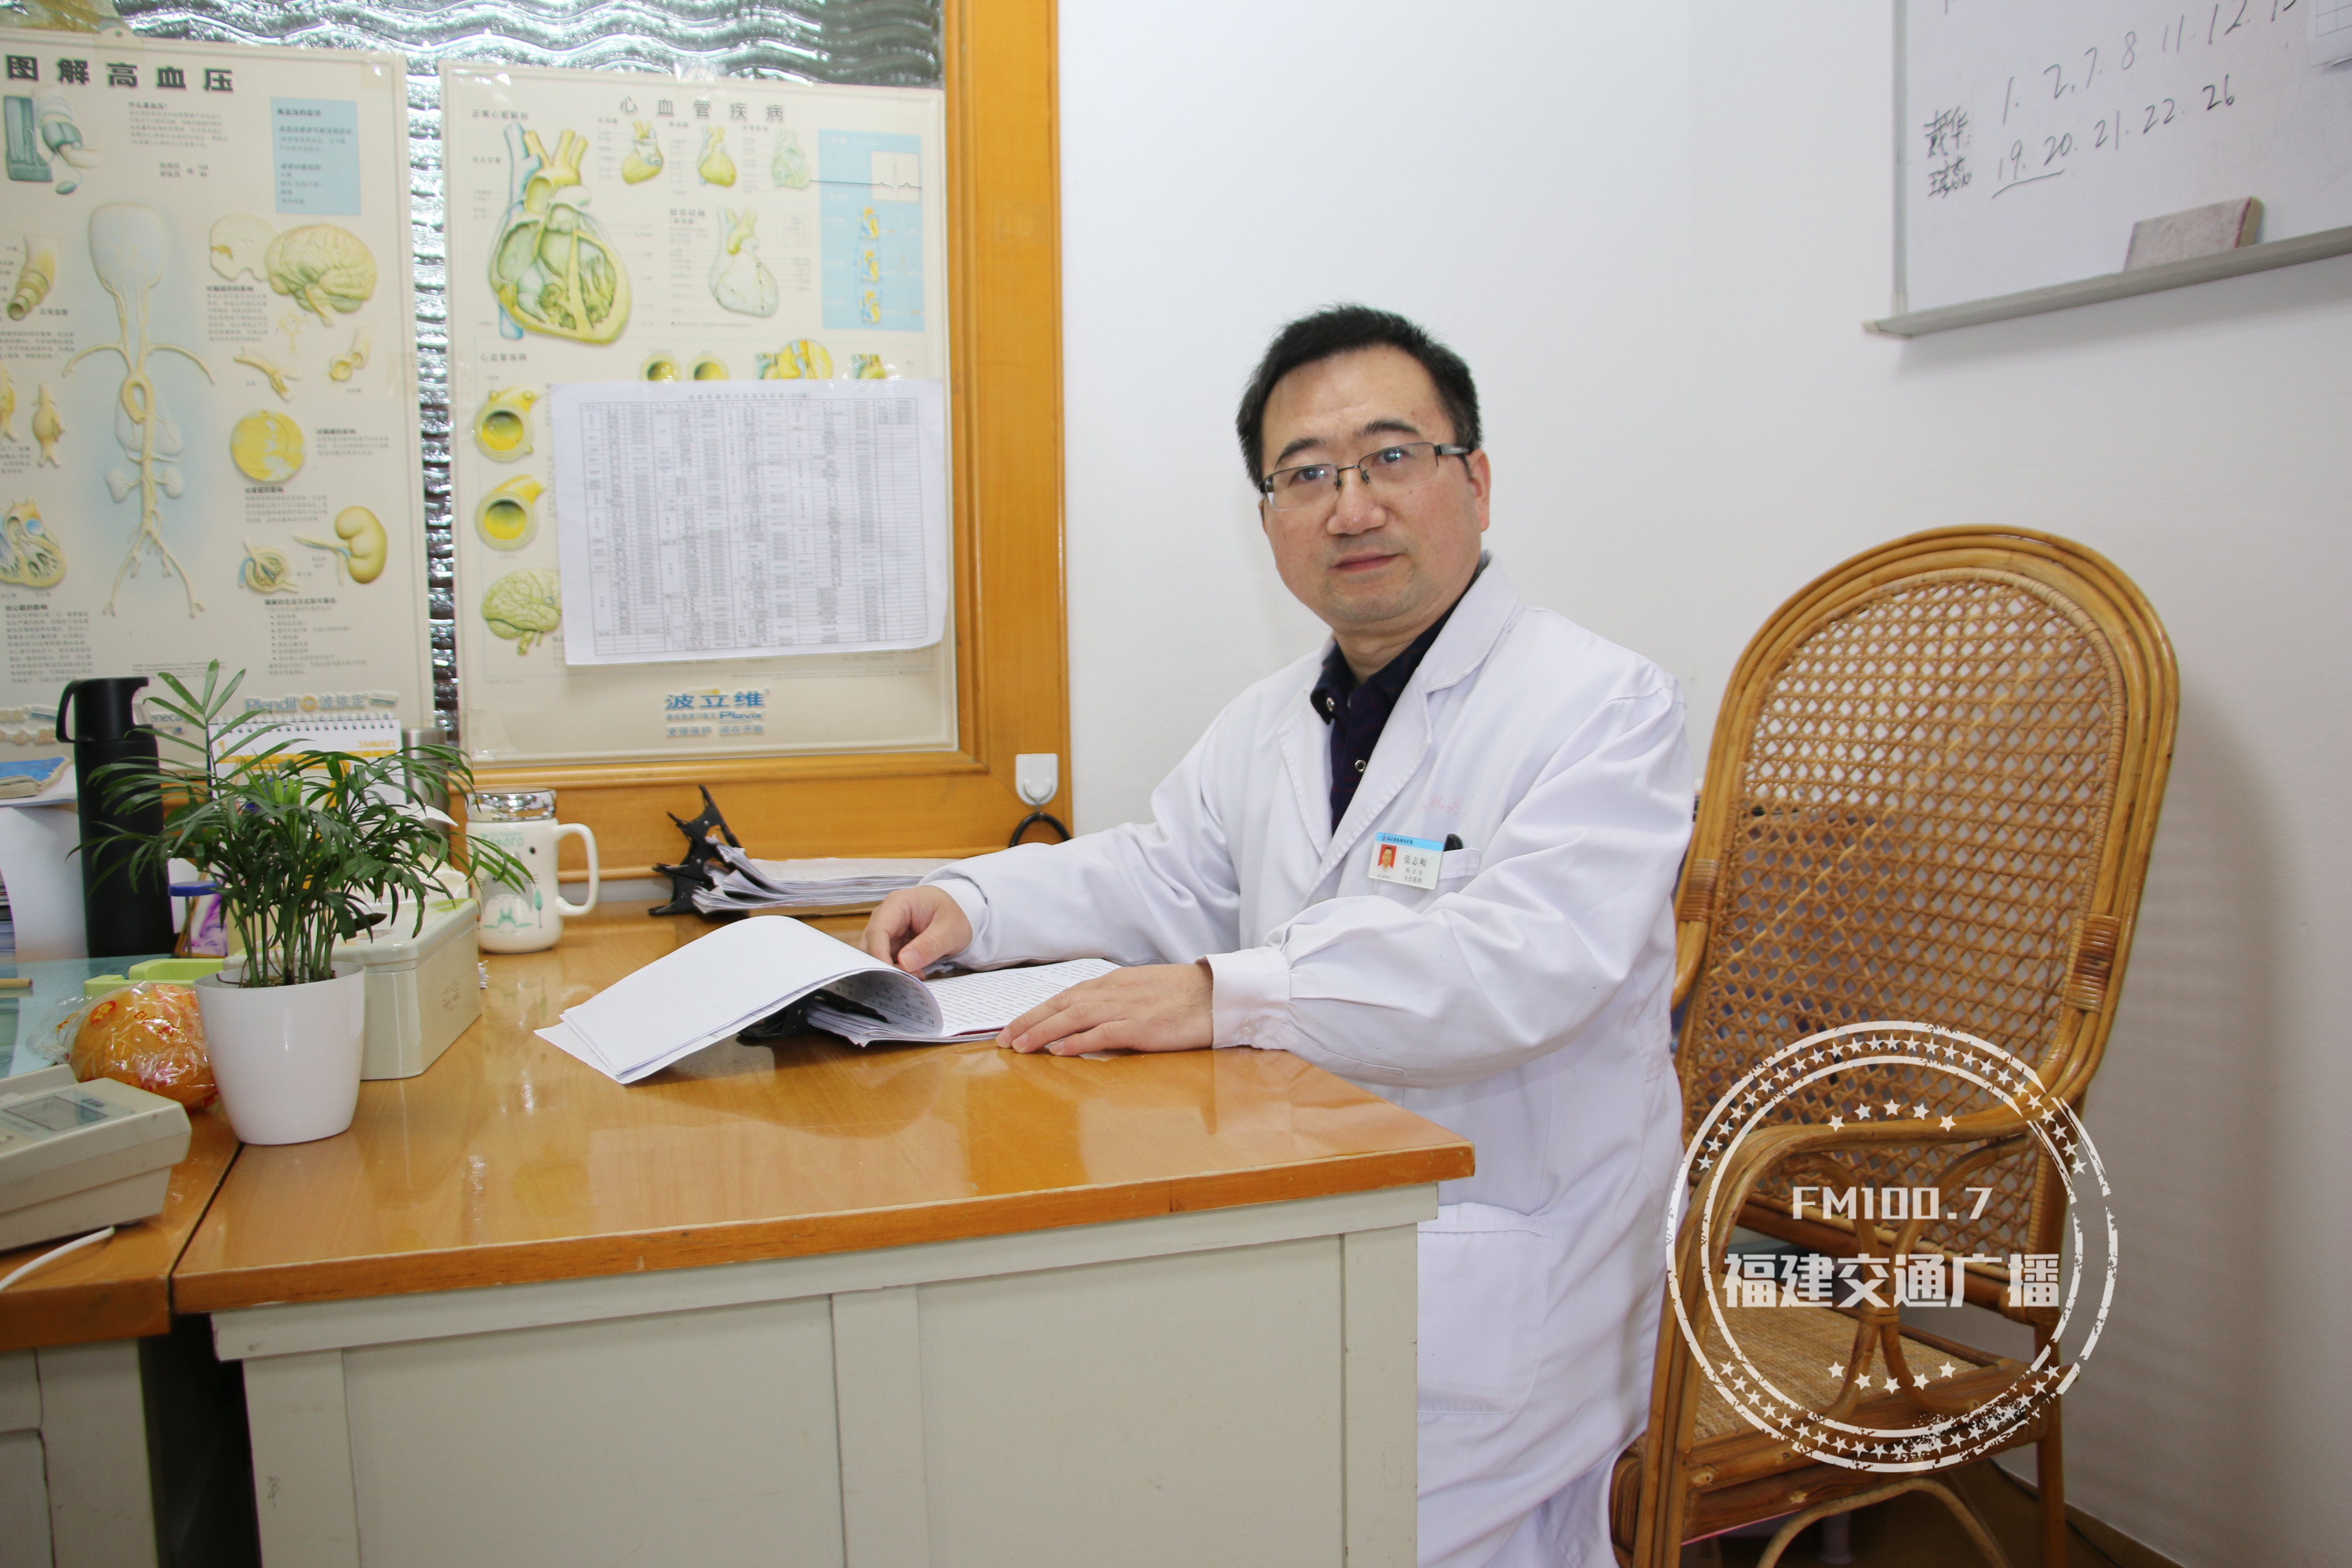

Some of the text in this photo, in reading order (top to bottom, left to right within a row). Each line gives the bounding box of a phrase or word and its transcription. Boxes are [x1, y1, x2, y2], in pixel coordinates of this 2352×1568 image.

[5, 54, 234, 92] 图解高血压
[277, 108, 322, 116] 高血压的症状
[620, 95, 785, 122] 心血管疾病
[472, 110, 529, 120] 正常心脏解剖
[480, 353, 527, 362] 心血管疾病
[245, 696, 297, 711] Plendil
[318, 694, 366, 709] 波依定
[664, 690, 765, 709] 波立维
[719, 710, 763, 719] Plavix
[720, 725, 764, 734] 现在开始
